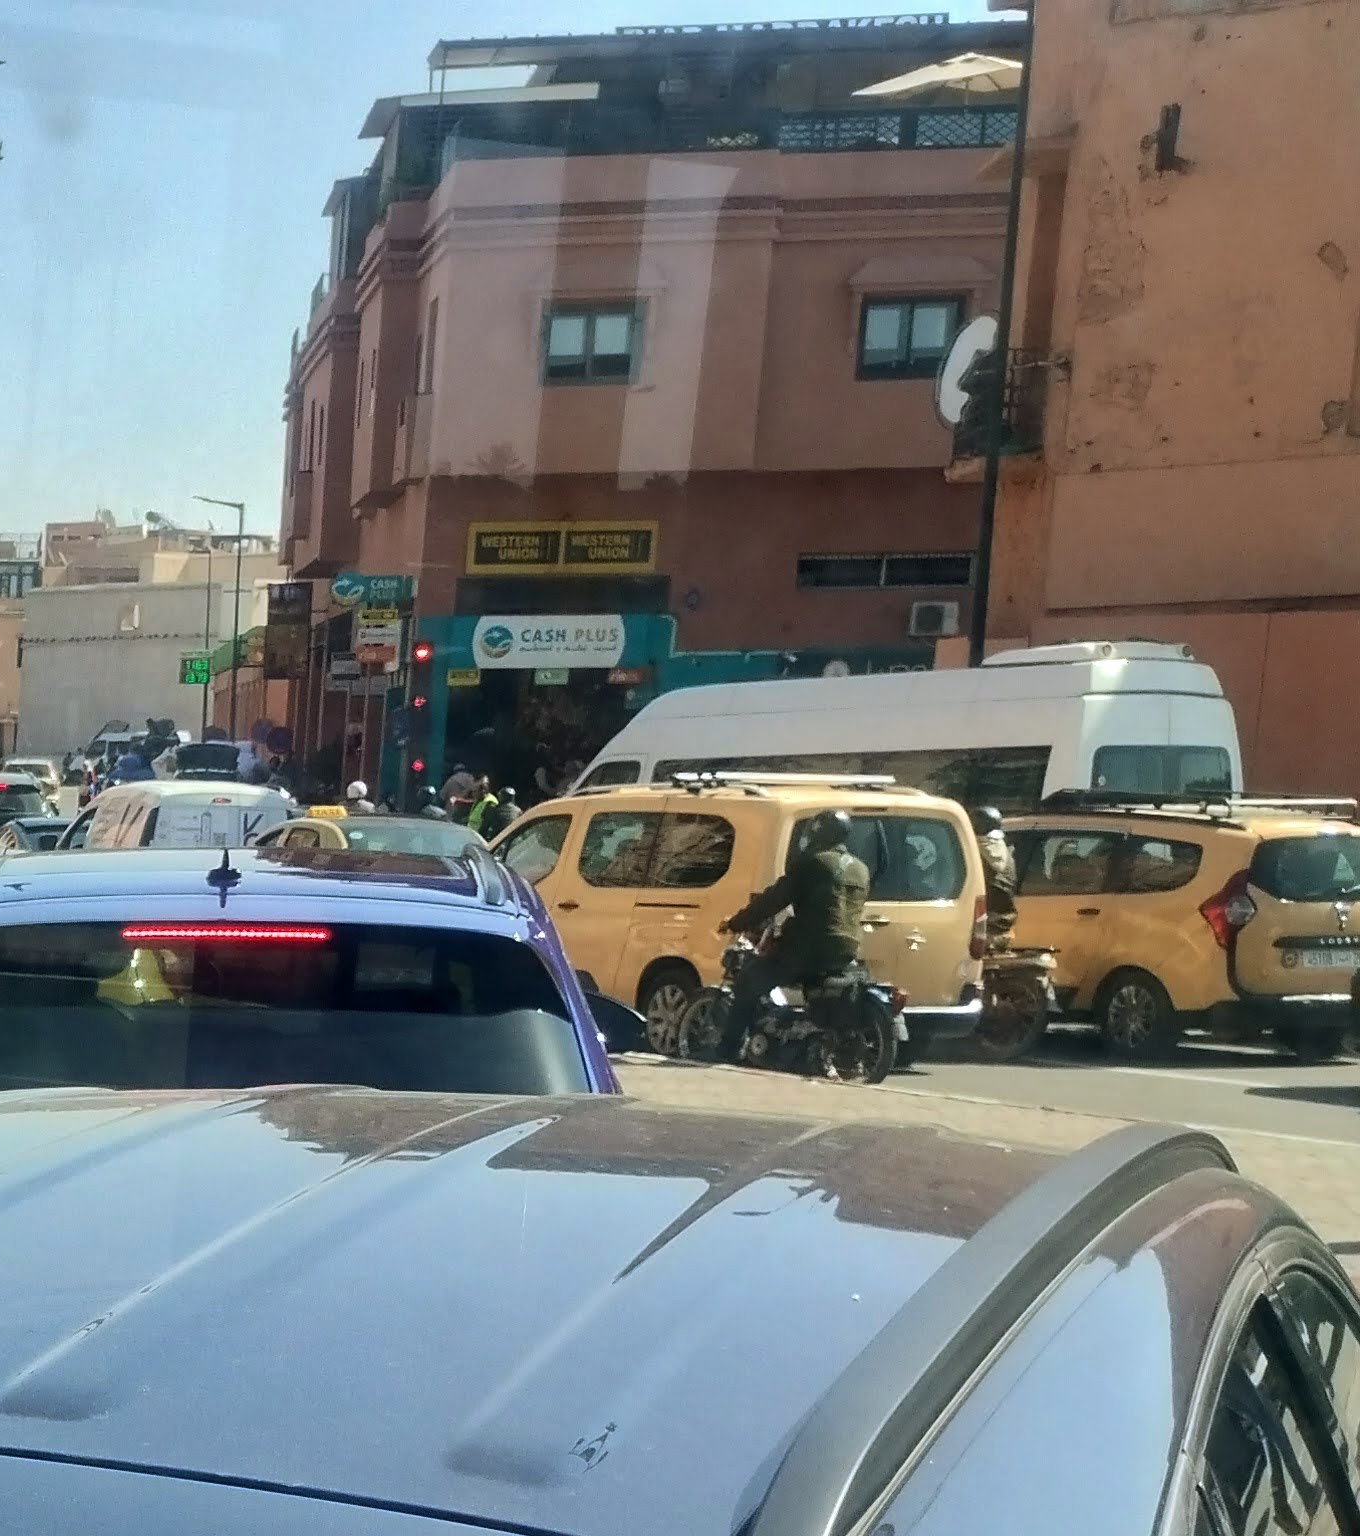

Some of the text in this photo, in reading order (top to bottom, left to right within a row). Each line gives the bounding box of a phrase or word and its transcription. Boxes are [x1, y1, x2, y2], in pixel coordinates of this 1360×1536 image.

[481, 535, 540, 548] WESTERN
[571, 534, 630, 547] WESTERN
[497, 547, 539, 560] UNION
[587, 547, 630, 560] UNION
[521, 628, 619, 643] CASH PLUS
